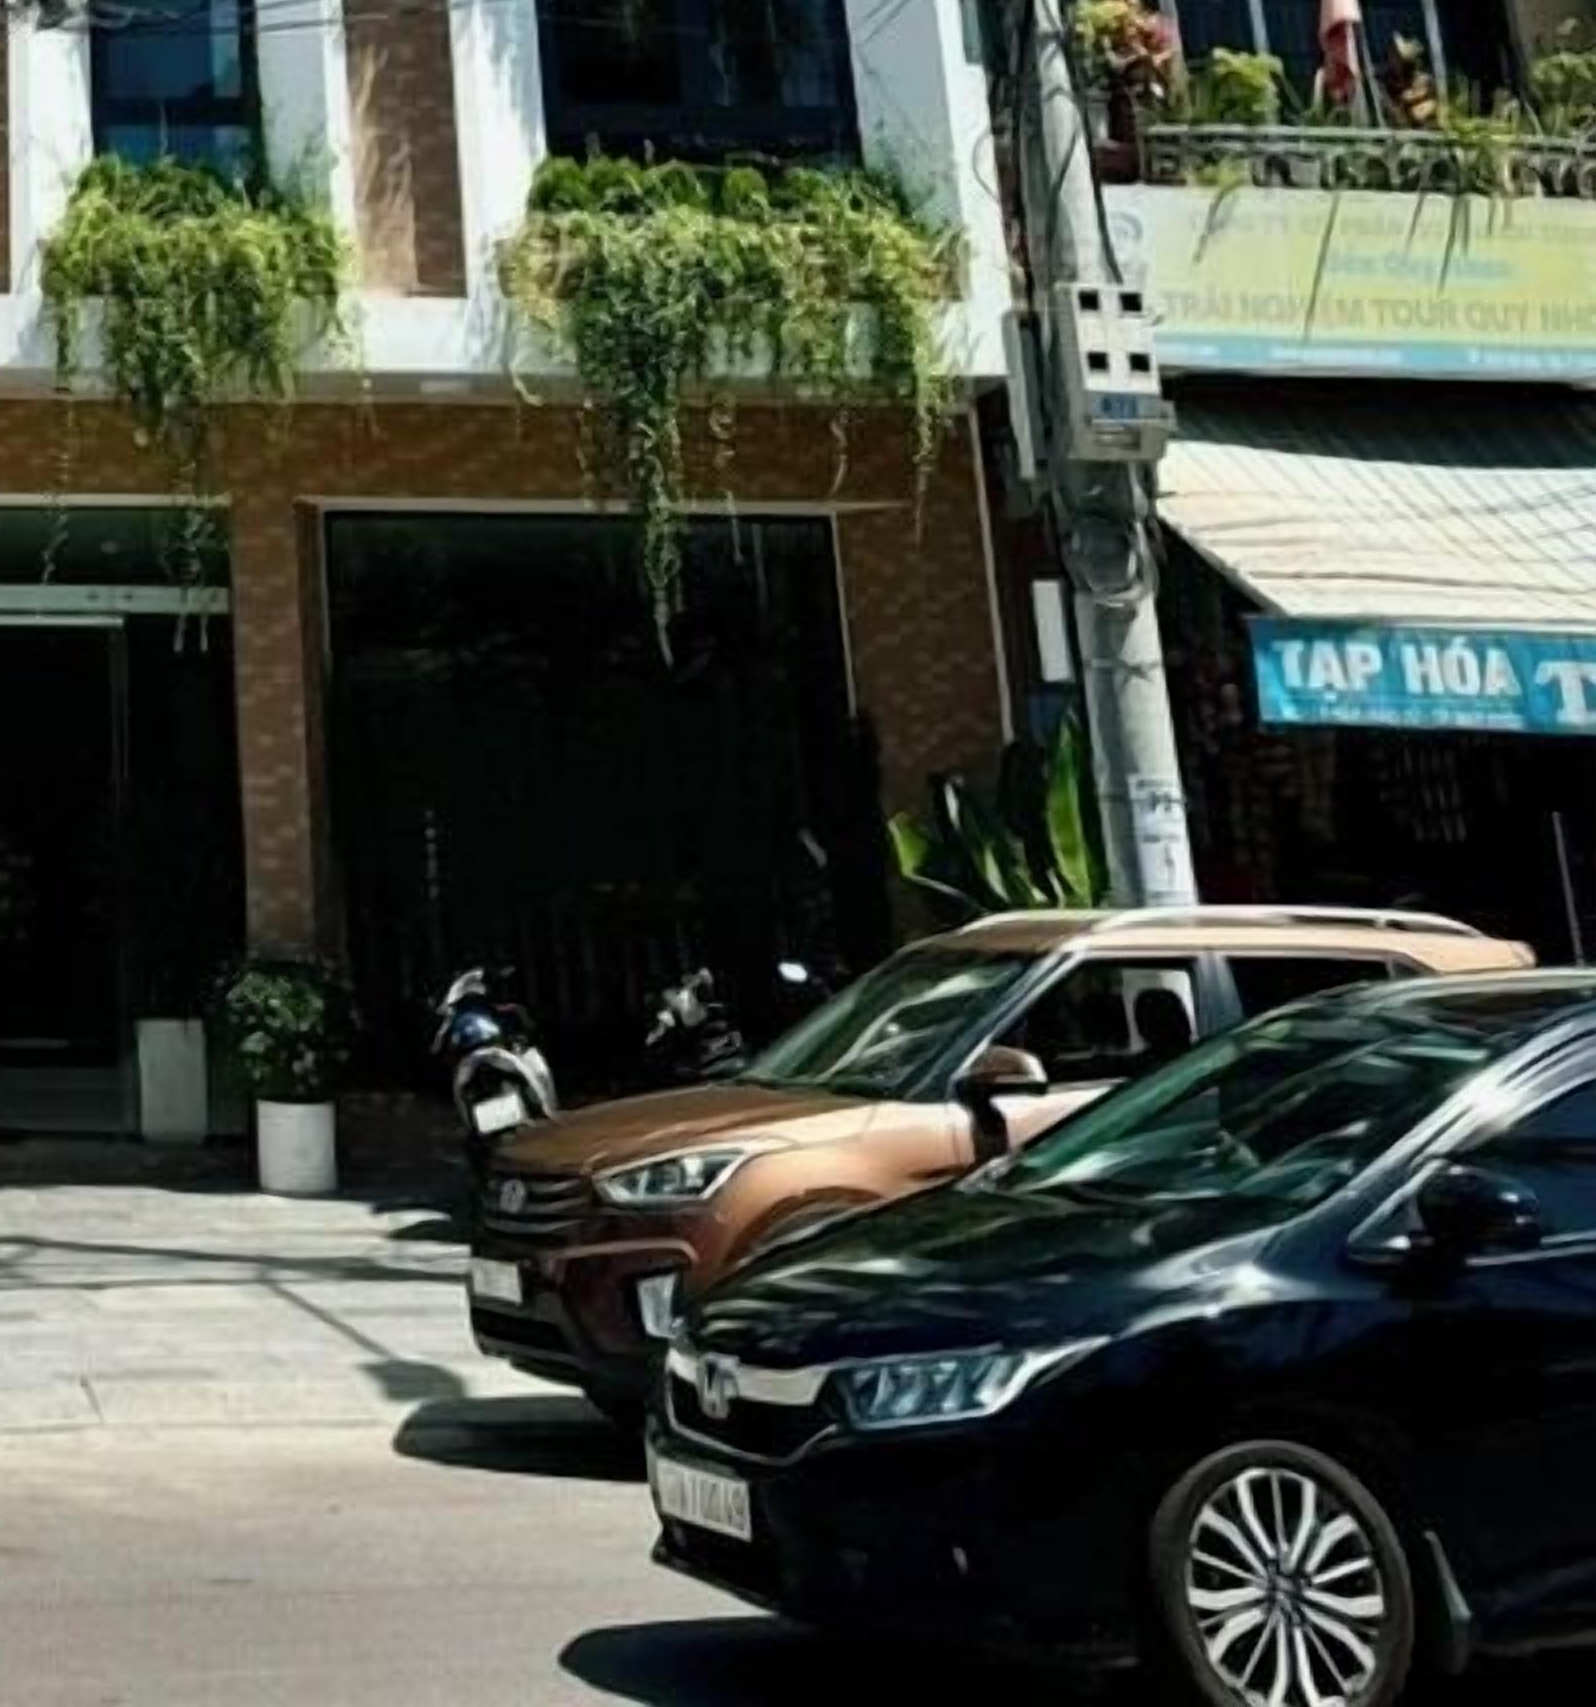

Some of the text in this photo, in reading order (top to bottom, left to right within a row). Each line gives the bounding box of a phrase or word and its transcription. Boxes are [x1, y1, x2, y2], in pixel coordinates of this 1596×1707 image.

[1368, 297, 1458, 329] TOUR
[1464, 300, 1529, 333] QUY
[1271, 640, 1383, 703] TẠP
[1401, 635, 1523, 697] HÓA
